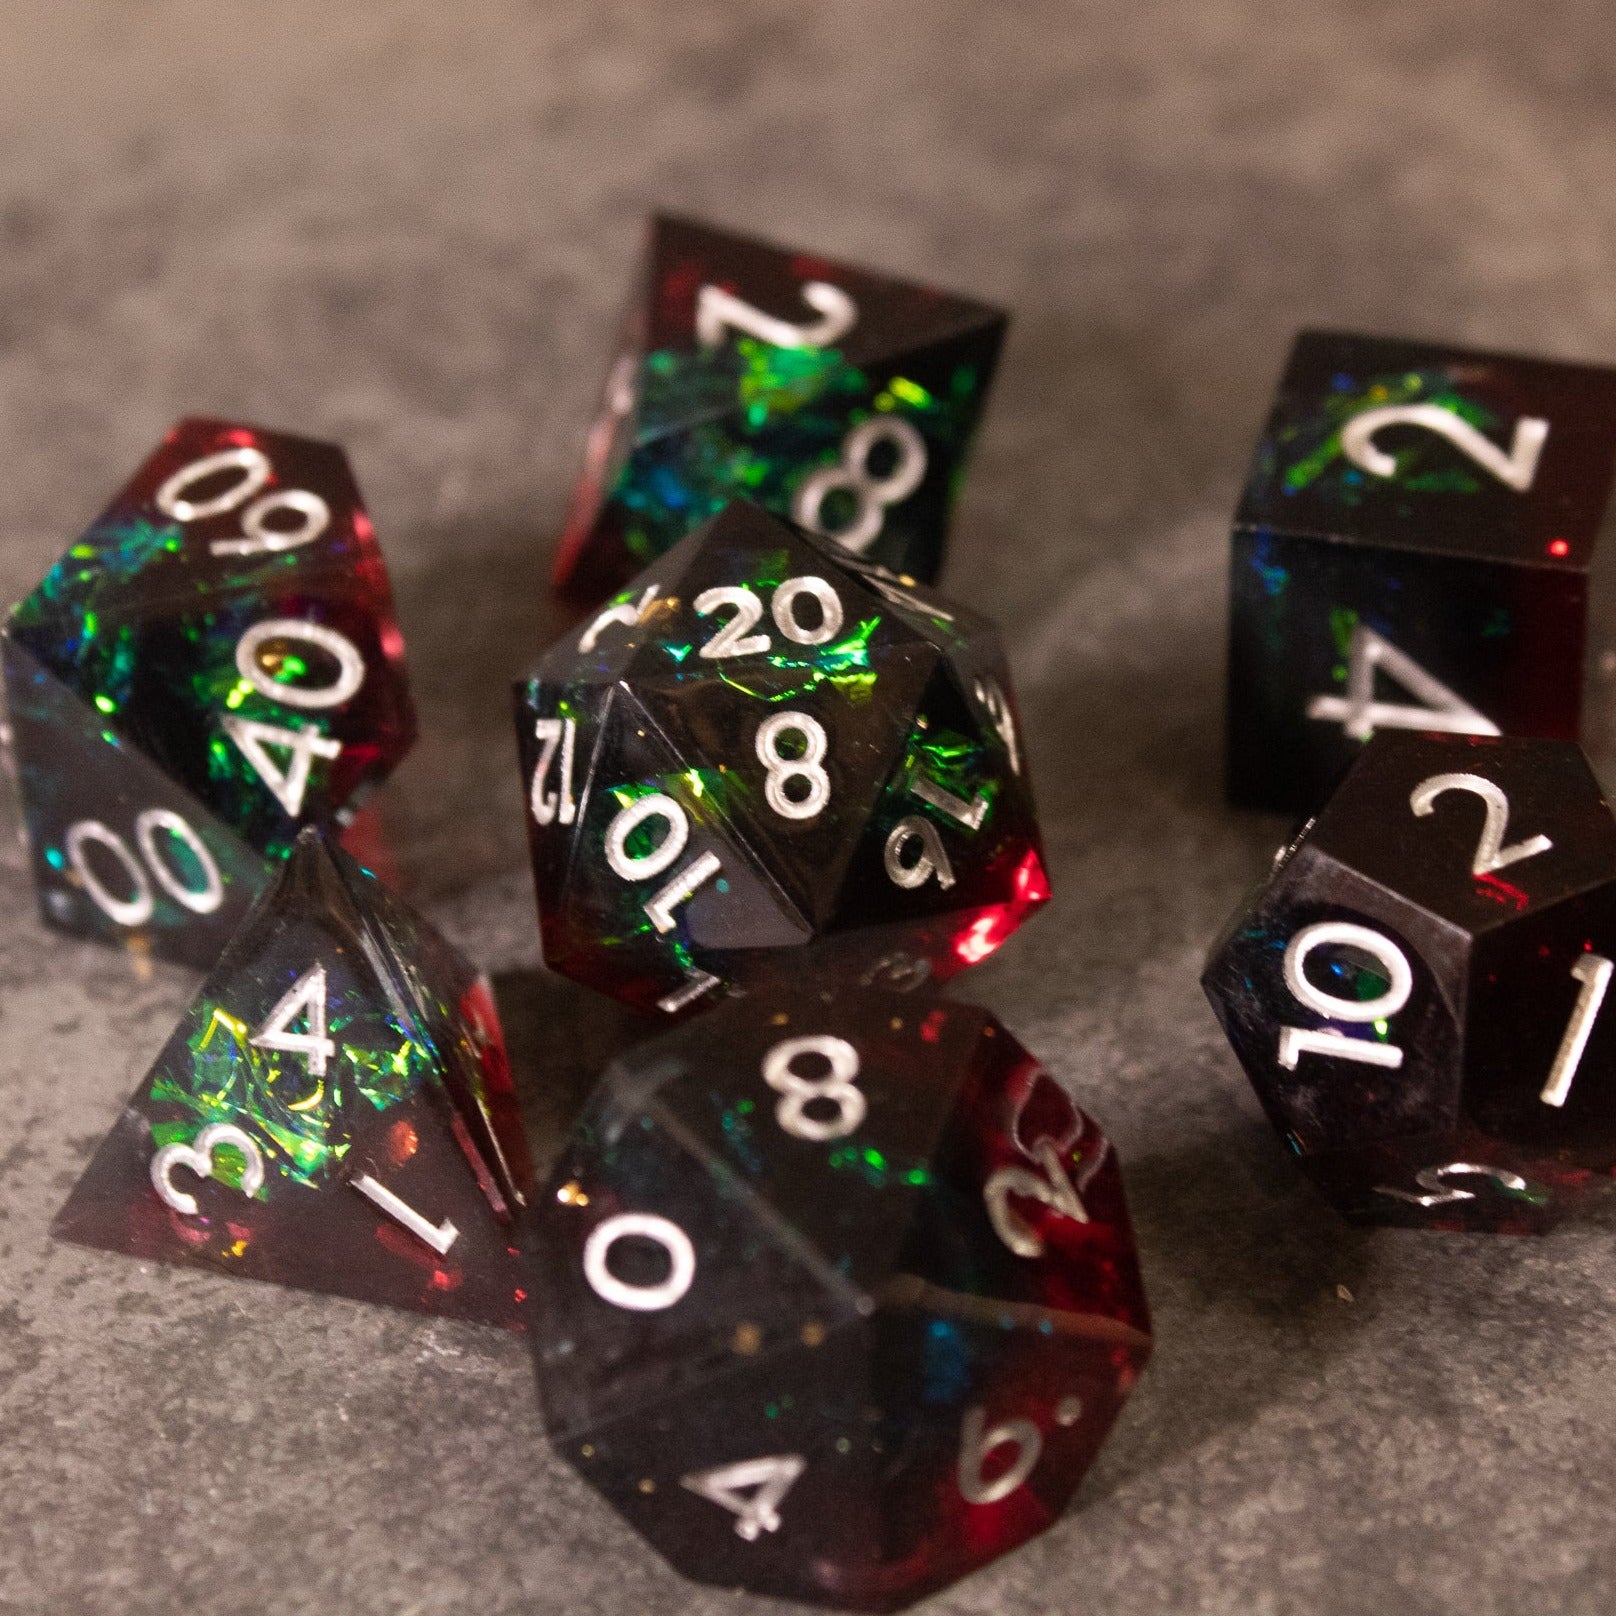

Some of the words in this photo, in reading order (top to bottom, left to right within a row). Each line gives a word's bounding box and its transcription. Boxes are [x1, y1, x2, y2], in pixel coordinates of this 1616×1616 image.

[696, 281, 858, 348] 2
[791, 413, 928, 554] 8
[1341, 403, 1551, 492] 2
[693, 575, 844, 659] 20
[219, 618, 366, 818] 40
[1306, 625, 1503, 738] 4
[531, 718, 577, 826] 12
[754, 711, 830, 819] 8
[66, 808, 223, 926] 00
[604, 793, 721, 933] 10
[1409, 772, 1554, 875] 2
[249, 961, 335, 1077] 4
[1278, 921, 1413, 1070] 10
[1539, 953, 1614, 1107] 1
[762, 1034, 868, 1140] 8
[150, 1122, 265, 1215] 3
[347, 1173, 460, 1256] 1
[583, 1212, 696, 1311] 0
[680, 1453, 808, 1541] 4
